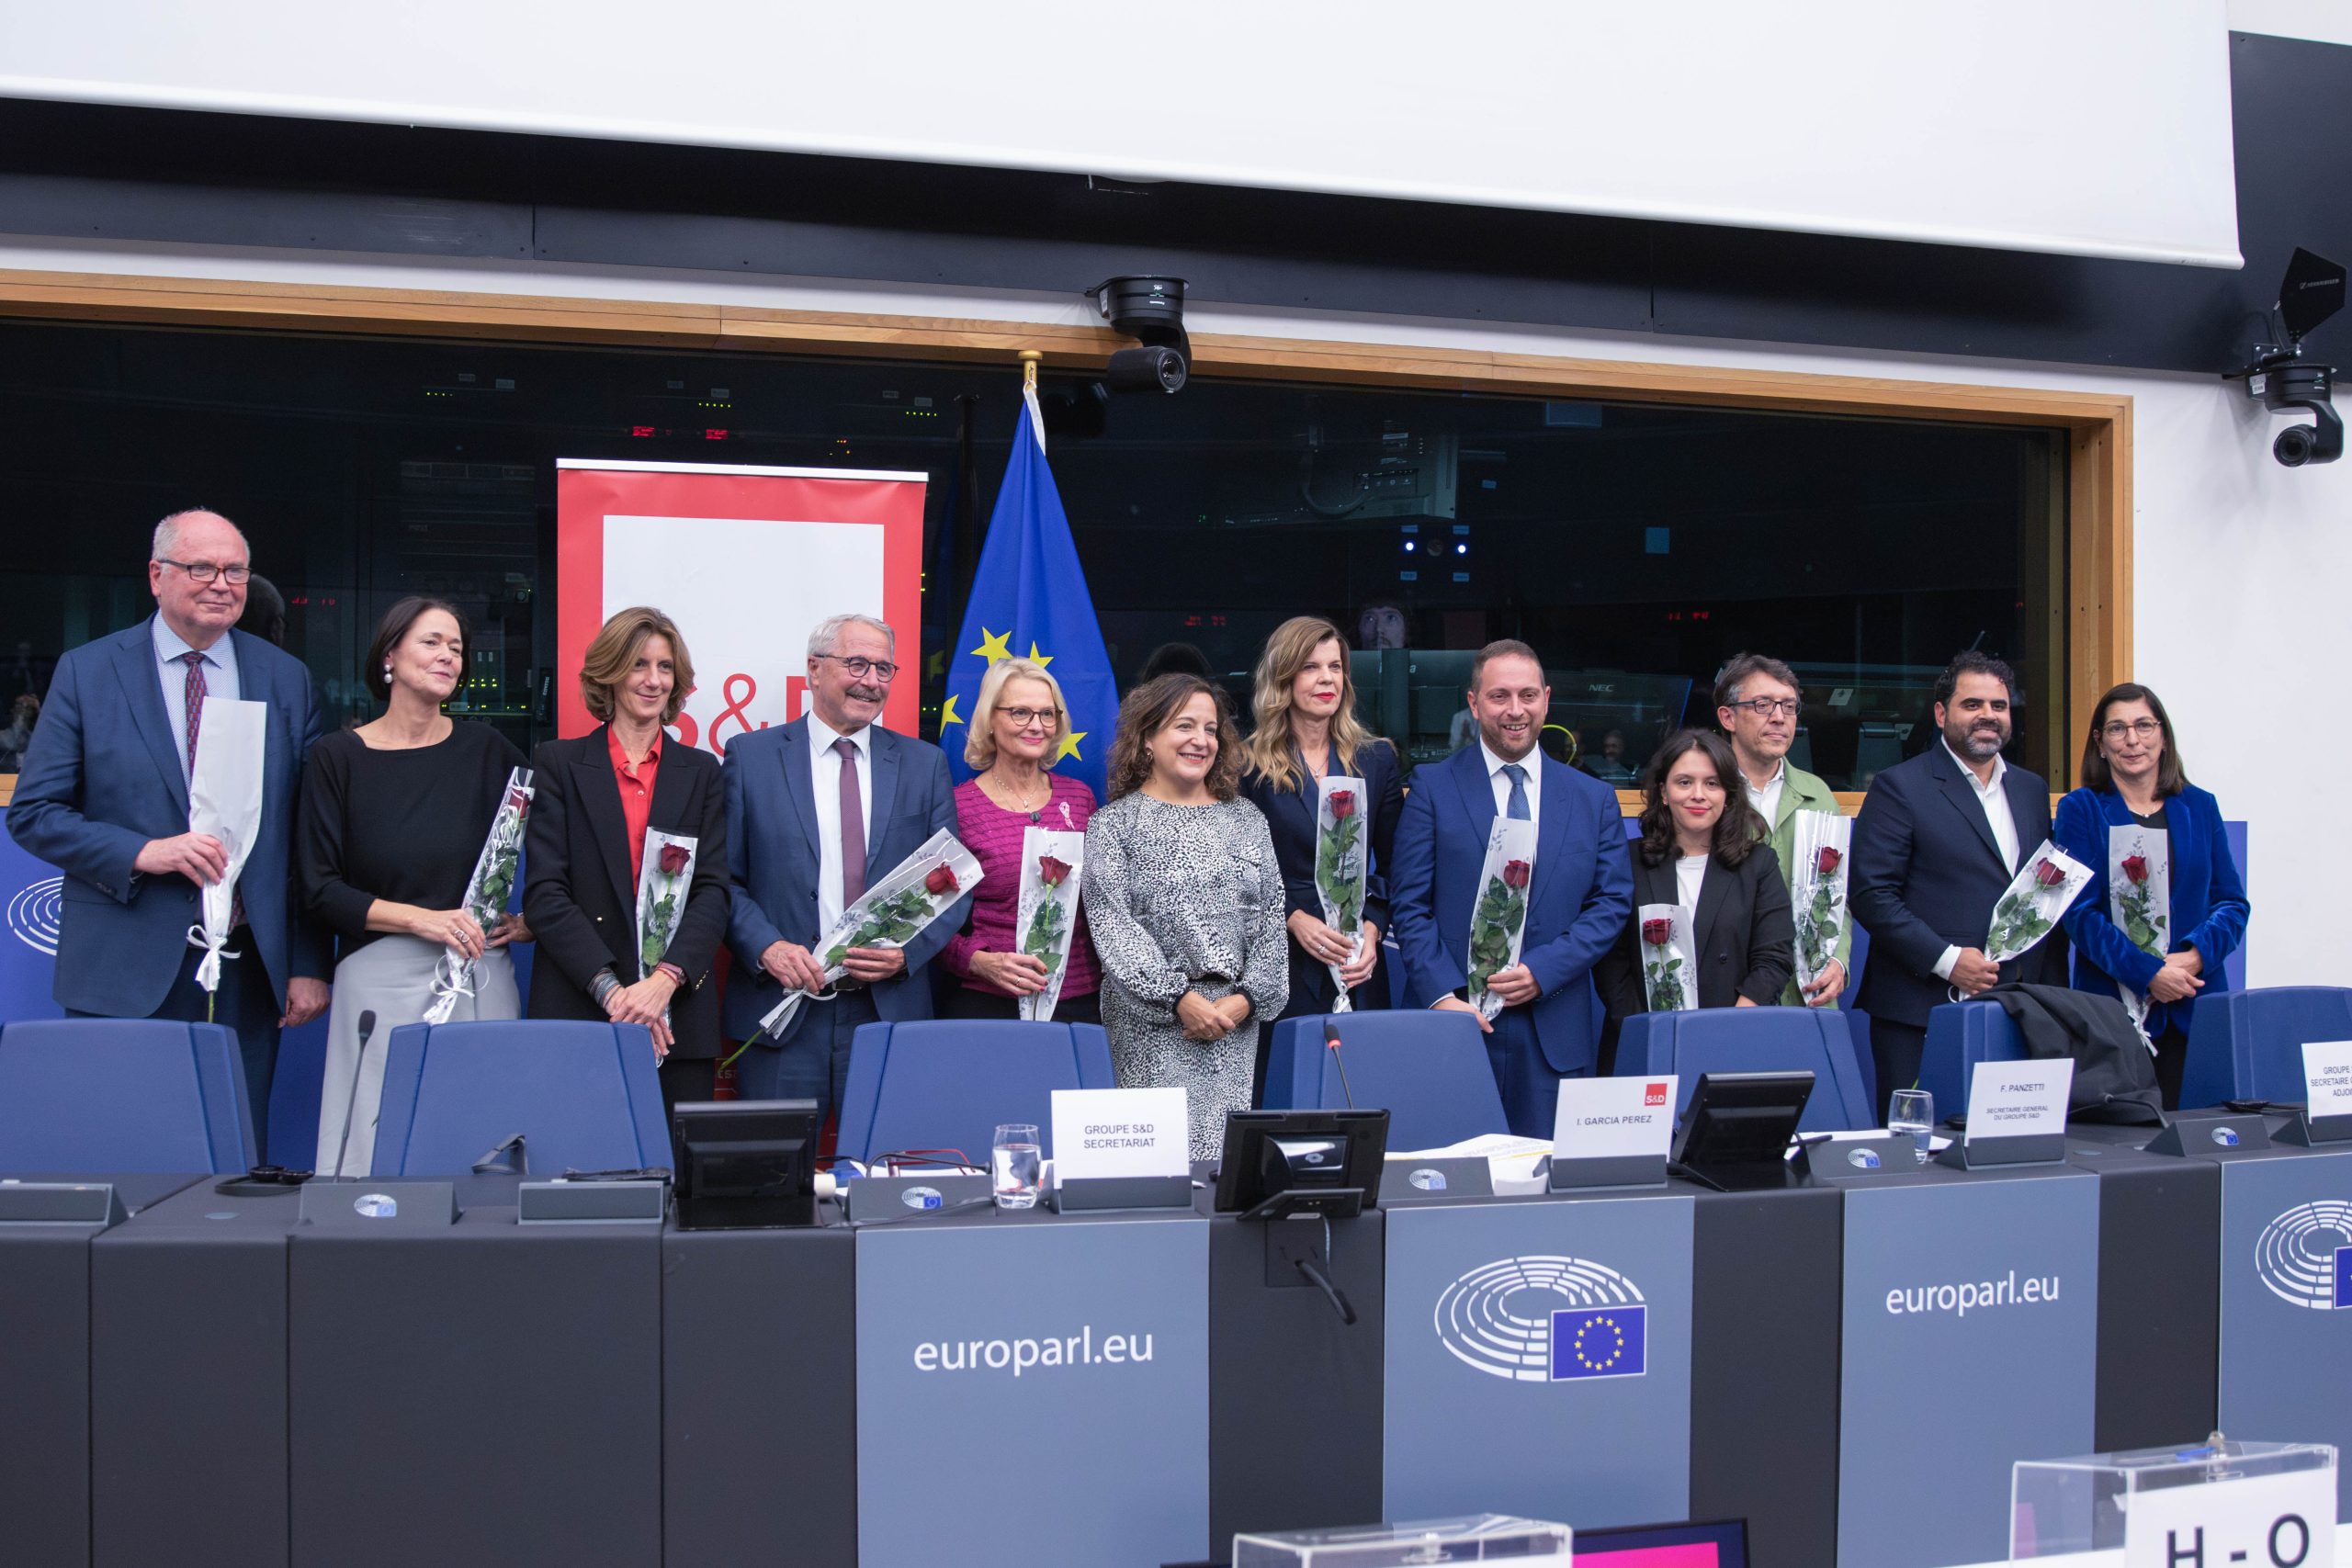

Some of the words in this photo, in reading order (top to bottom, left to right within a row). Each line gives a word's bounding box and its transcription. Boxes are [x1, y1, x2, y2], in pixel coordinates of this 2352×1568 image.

[1589, 683, 1614, 693] NEC
[2323, 1066, 2350, 1075] GROUPE
[2000, 1085, 2007, 1093] F.
[2008, 1083, 2045, 1092] PANZETTI
[2311, 1077, 2349, 1087] SECRETAIRE
[1584, 1116, 1620, 1126] GARCIA
[1622, 1114, 1653, 1124] PEREZ
[2003, 1112, 2027, 1121] GROUPE
[1084, 1124, 1129, 1135] GROUPE
[1132, 1123, 1154, 1134] S&D
[1083, 1137, 1155, 1149] SECRETARIAT
[1886, 1269, 2059, 1317] europarl.eu
[914, 1325, 1153, 1377] europarl.eu
[2166, 1526, 2205, 1568] H
[2267, 1513, 2311, 1568] O
